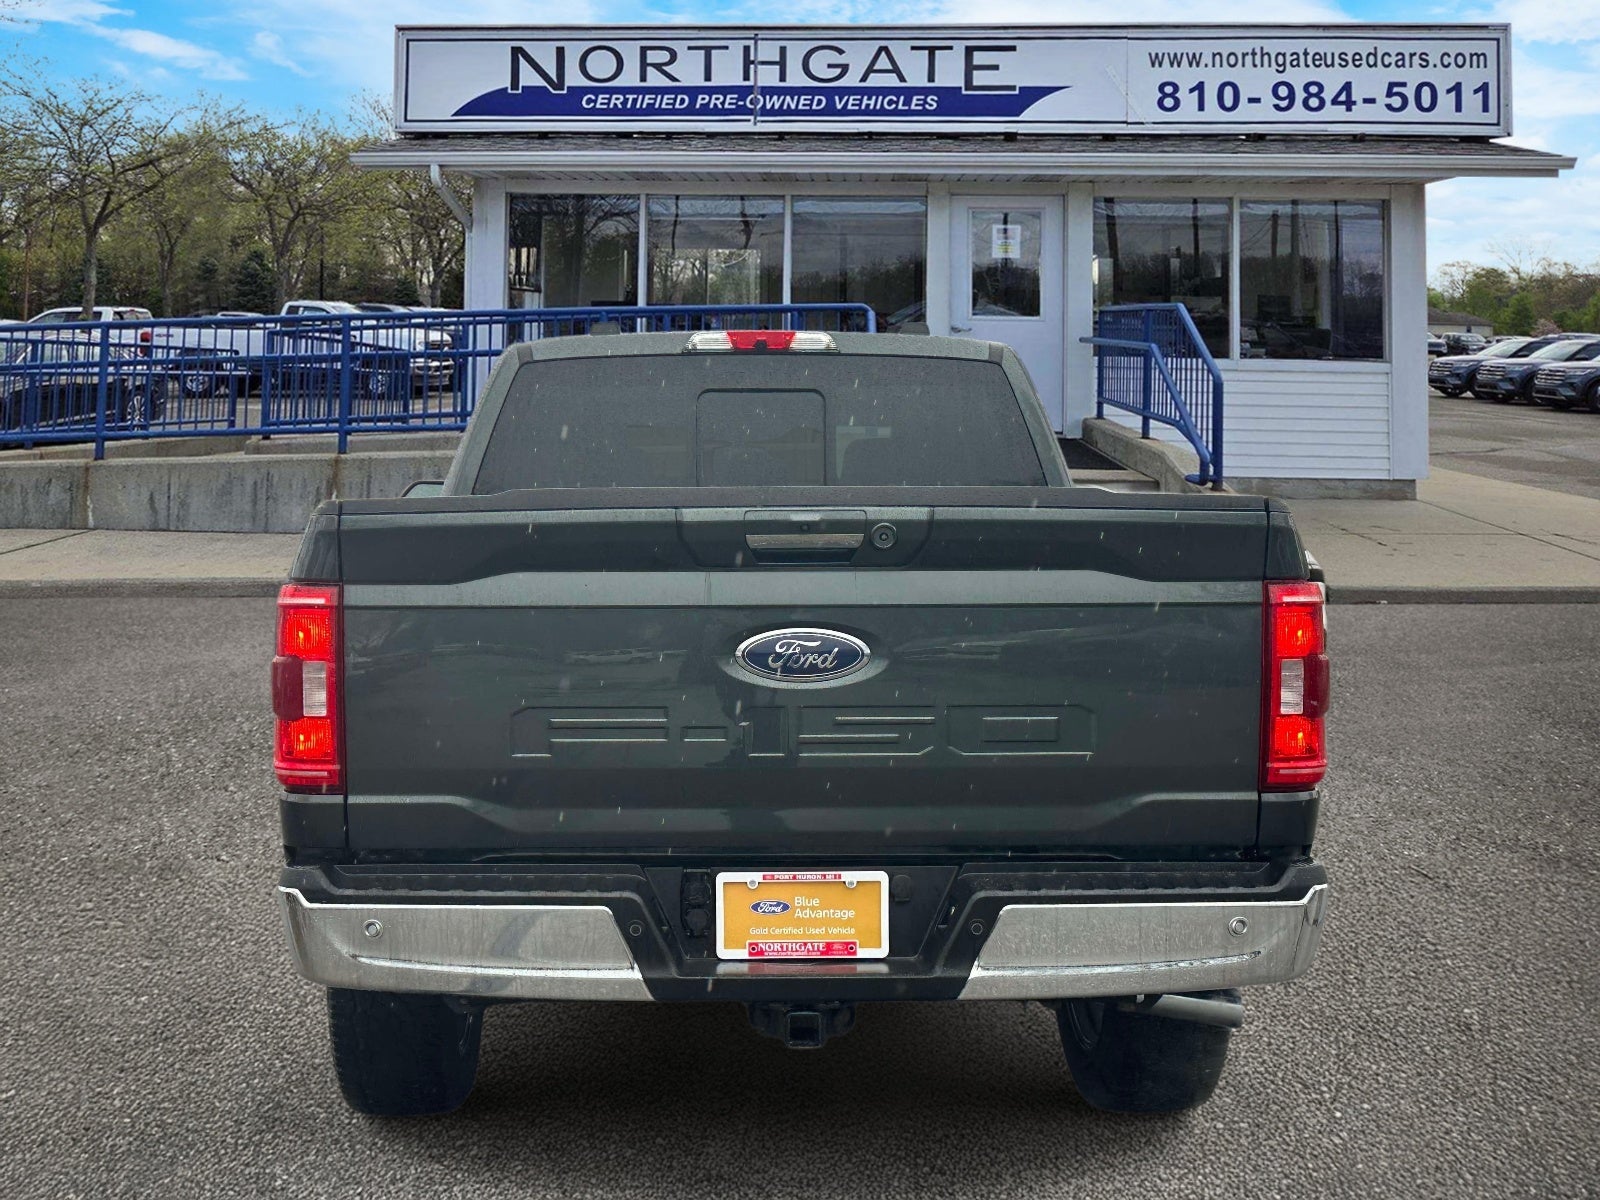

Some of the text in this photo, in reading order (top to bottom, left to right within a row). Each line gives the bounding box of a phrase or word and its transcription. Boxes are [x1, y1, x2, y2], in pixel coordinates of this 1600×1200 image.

[1148, 46, 1488, 73] www.northgateusedcars.com
[510, 44, 1017, 92] NORTHGATE
[581, 94, 938, 110] CERTIFIED PRE-OWNED VEHICLES
[1156, 80, 1491, 113] 810-984-5011
[768, 639, 839, 669] Ford
[757, 901, 783, 913] Ford
[794, 896, 820, 907] Blue
[794, 908, 856, 920] Advantage
[749, 927, 855, 935] Gold Certified Used Vehicle
[758, 942, 826, 952] NORTHGATE
